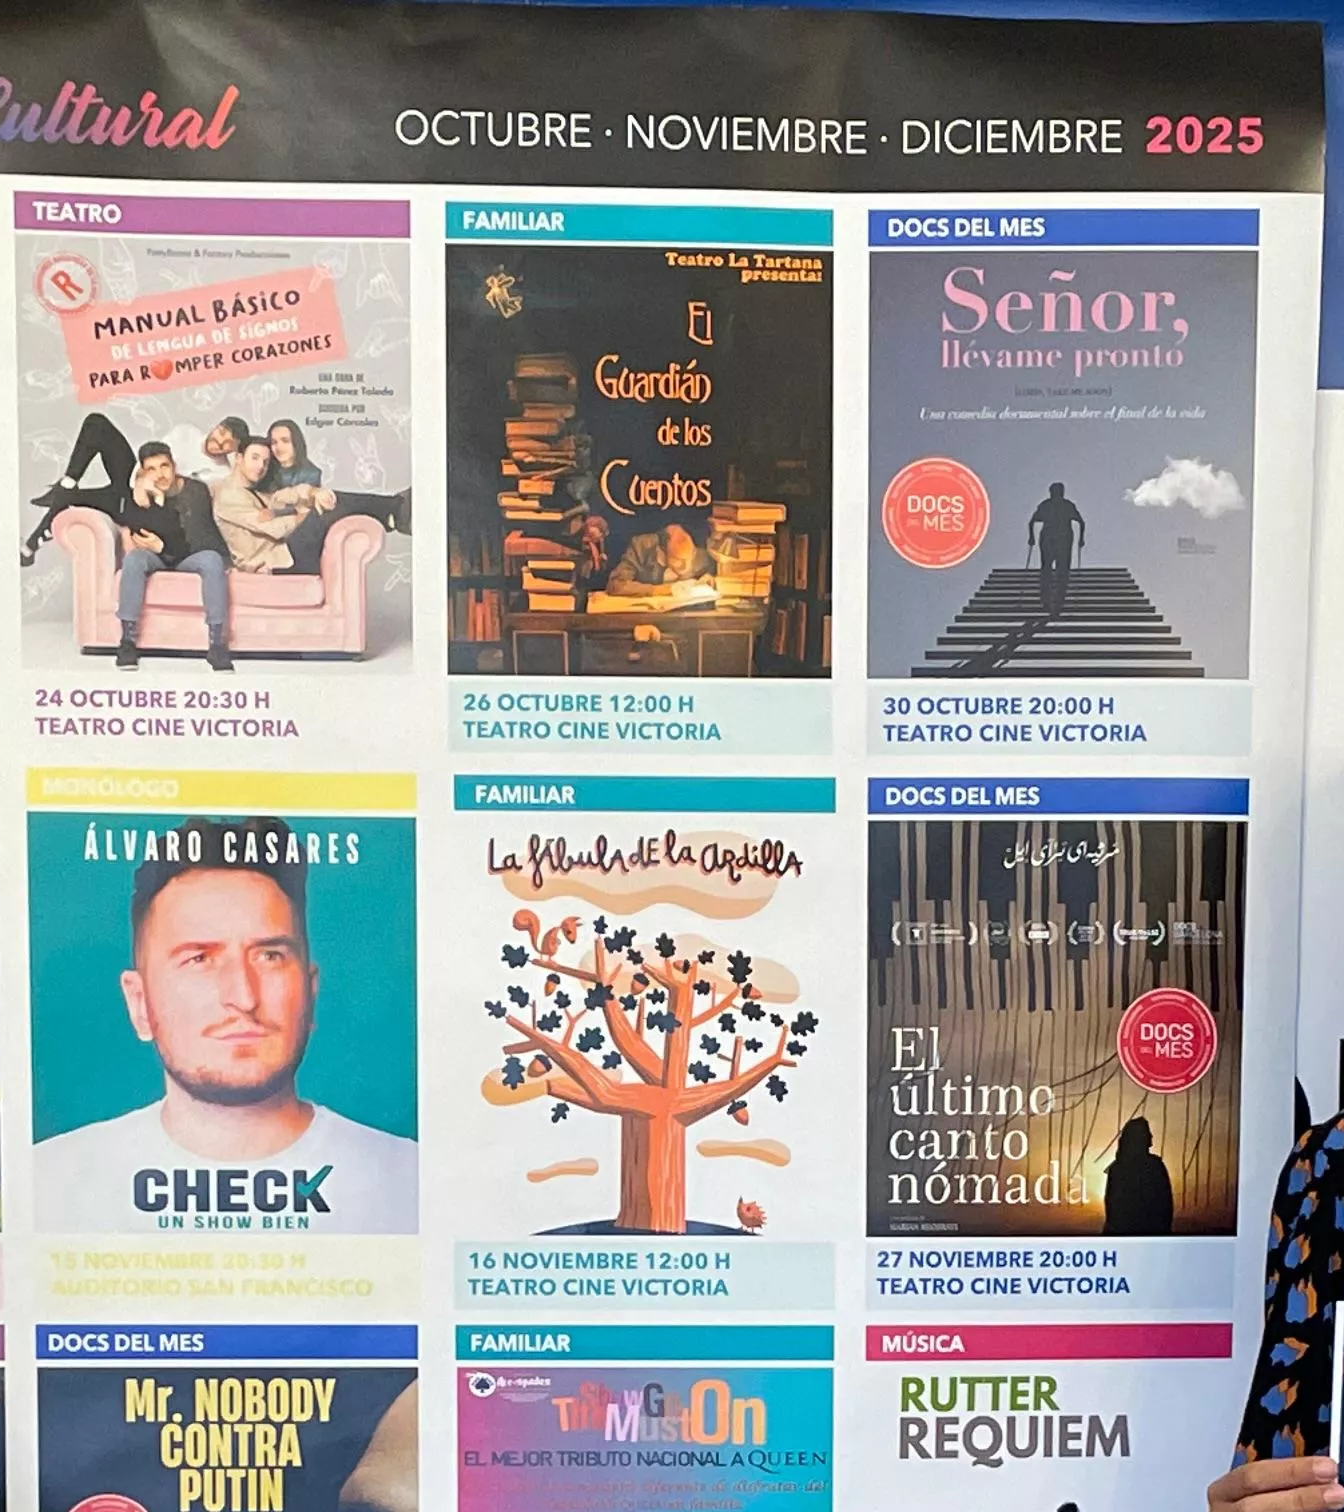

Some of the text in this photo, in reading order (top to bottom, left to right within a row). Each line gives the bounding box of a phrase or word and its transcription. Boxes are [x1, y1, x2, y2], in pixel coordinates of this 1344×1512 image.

[396, 110, 1263, 154] OCTUBRE NOVIEMBRE DICIEMBRE 2025
[33, 202, 121, 223] TEATRO
[464, 211, 563, 230] FAMILIAR
[889, 218, 1045, 237] DOCS DEL MES
[665, 252, 823, 270] Teatro La Tartana
[741, 268, 823, 283] presenta:
[942, 267, 1189, 342] Señor,
[689, 302, 713, 345] El
[943, 340, 1183, 377] llévame pronto
[596, 355, 711, 403] Guardián
[658, 418, 711, 445] de los
[600, 459, 712, 515] Cuentos
[886, 787, 1039, 805] DOCS DEL MES
[85, 823, 360, 866] ÁLVARO CASARES
[892, 1028, 942, 1073] El
[1140, 1023, 1194, 1042] DOCS
[1156, 1040, 1194, 1059] MES
[891, 1074, 1054, 1116] último
[888, 1123, 1029, 1161] canto
[133, 1164, 334, 1214] CHECK
[888, 1160, 1090, 1204] nómada
[159, 1216, 308, 1229] UN SHOW BIEN
[878, 1251, 1116, 1268] 27 NOVIEMBRE 20:00 H
[49, 1334, 203, 1351] DOCS DEL MES
[472, 1335, 569, 1351] FAMILIAR
[883, 1335, 964, 1352] MÚSICA
[126, 1377, 337, 1423] Mr. NOBODY
[902, 1376, 1059, 1412] RUTTER
[160, 1424, 302, 1468] CONTRA
[900, 1415, 1130, 1467] REQUIEM
[180, 1468, 284, 1512] PUTIN
